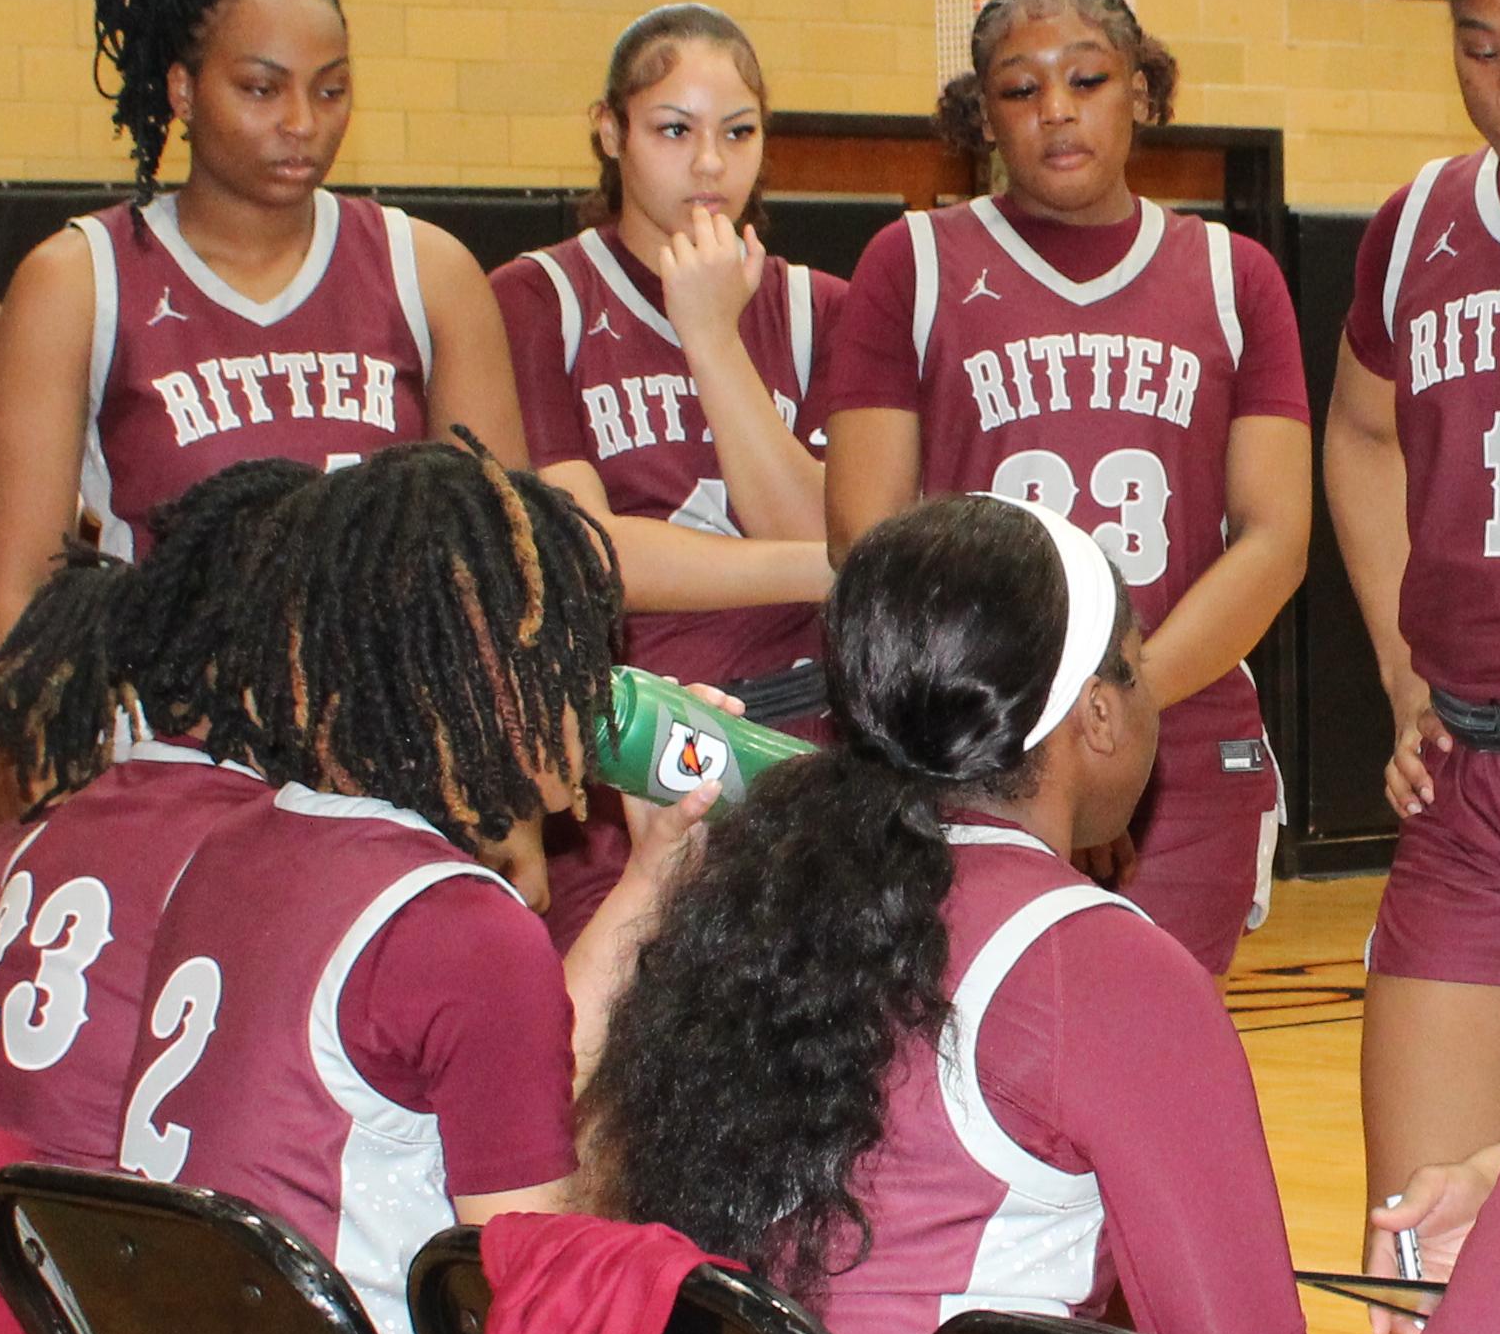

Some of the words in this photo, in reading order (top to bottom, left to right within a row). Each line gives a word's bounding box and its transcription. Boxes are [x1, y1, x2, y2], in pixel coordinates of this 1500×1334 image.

[152, 351, 398, 448] RITTER
[581, 373, 798, 461] RIT
[962, 332, 1202, 433] RITTER
[118, 955, 223, 1185] 2
